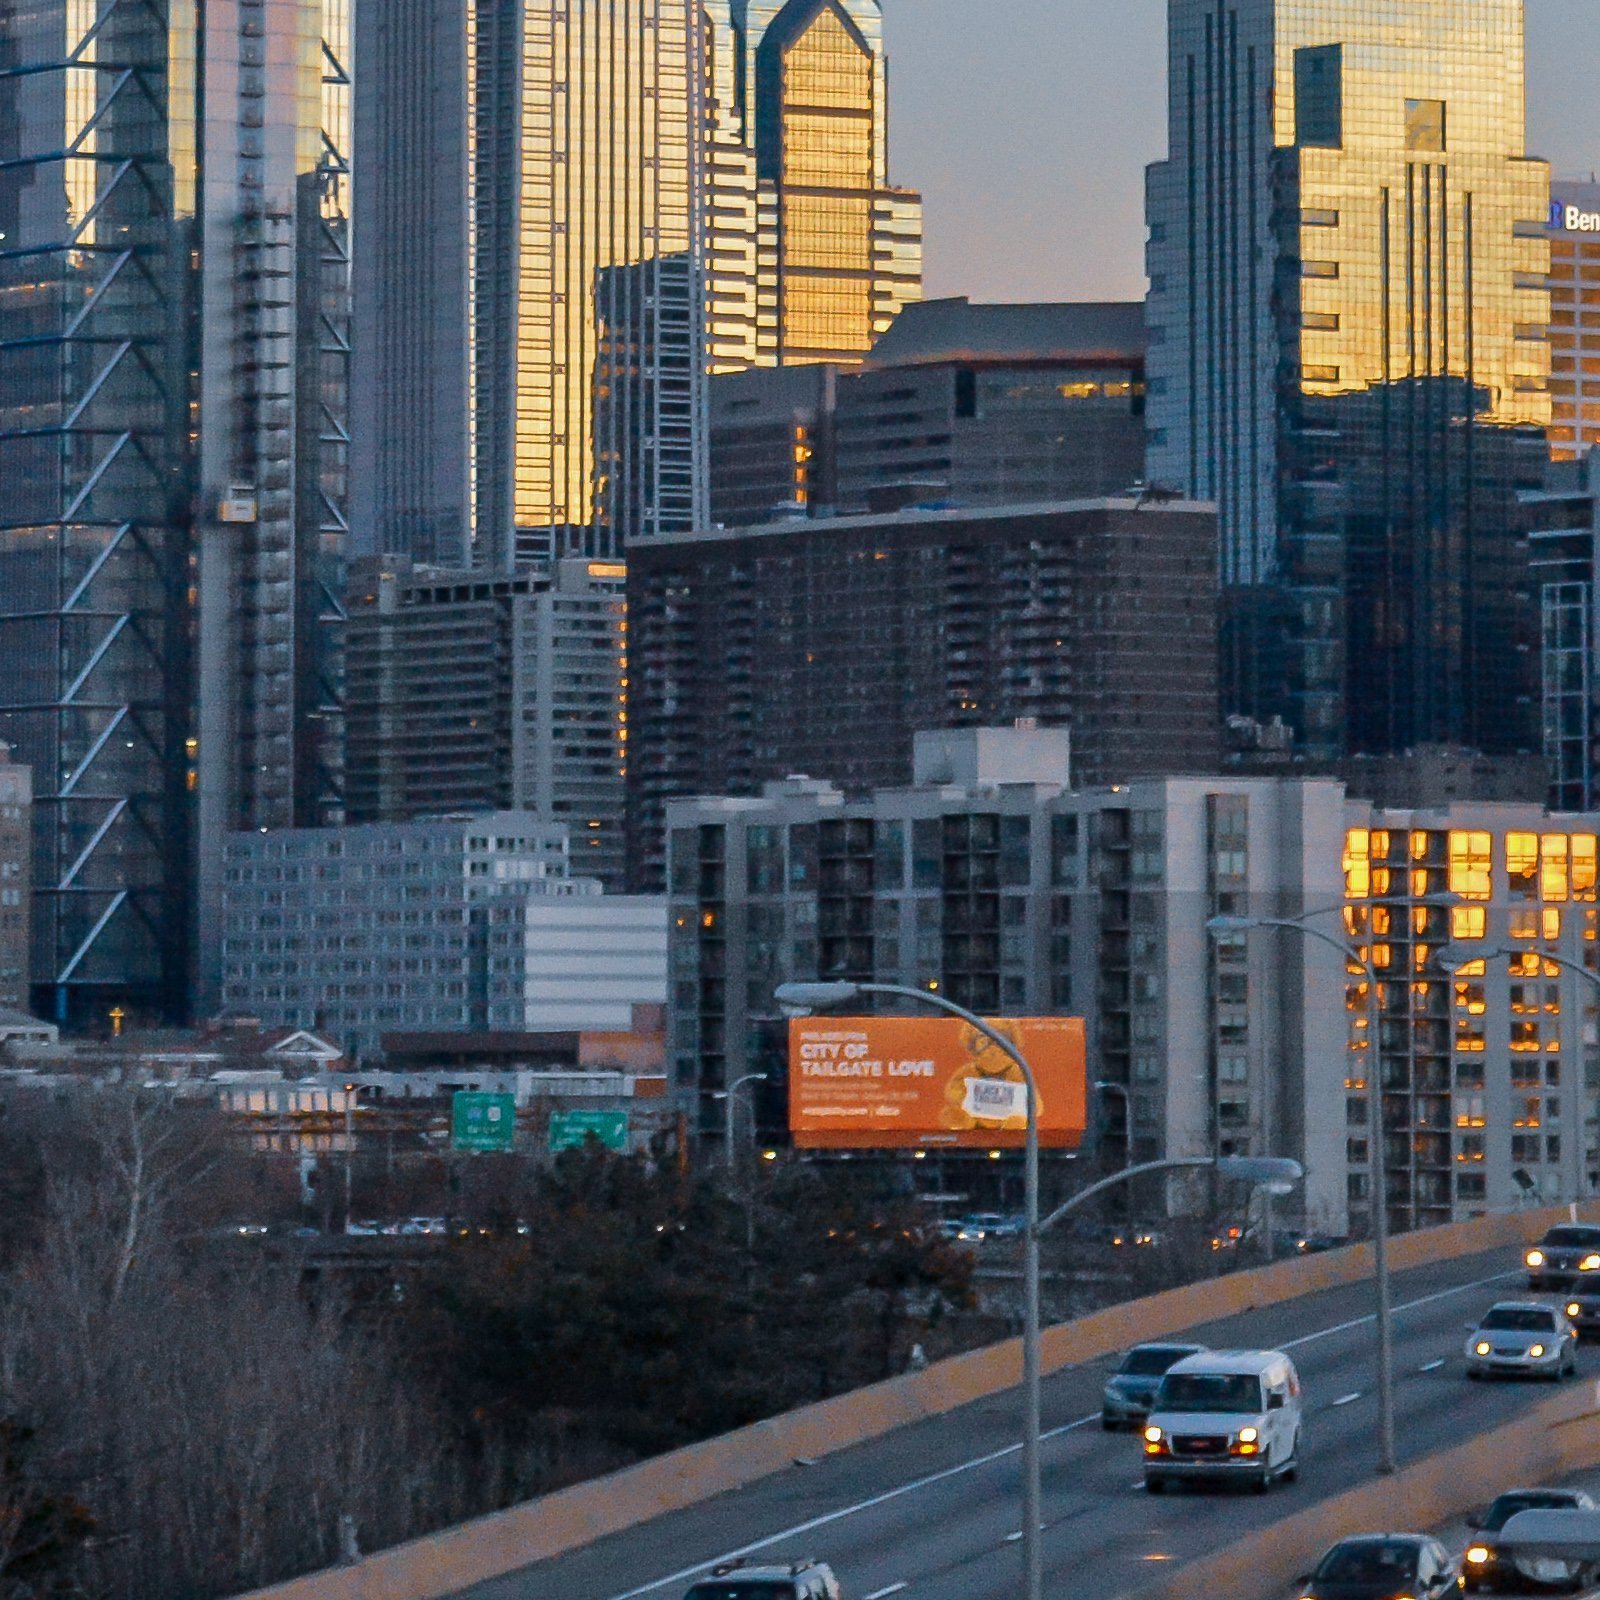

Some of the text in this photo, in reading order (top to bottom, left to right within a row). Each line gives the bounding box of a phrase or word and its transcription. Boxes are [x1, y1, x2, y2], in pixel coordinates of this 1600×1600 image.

[800, 1043, 869, 1058] CITY OF
[800, 1060, 935, 1076] TAILGATE LOVE
